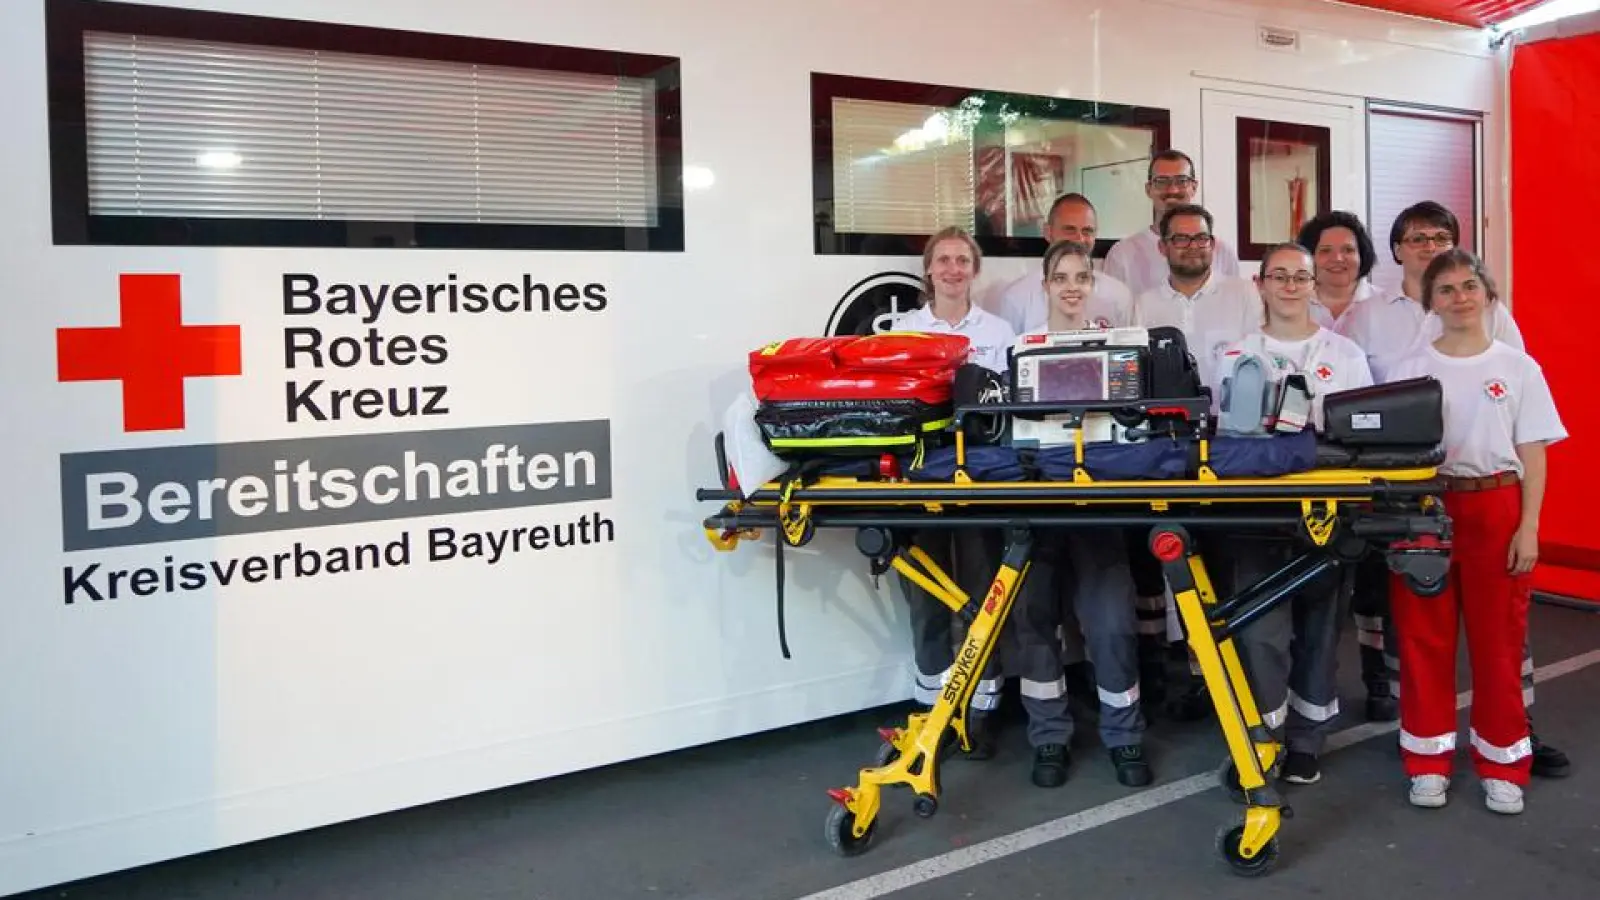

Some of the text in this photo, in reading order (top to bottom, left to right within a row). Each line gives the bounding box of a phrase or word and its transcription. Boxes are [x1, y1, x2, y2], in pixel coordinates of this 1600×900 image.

[282, 273, 607, 323] Bayerisches
[284, 327, 448, 369] Rotes
[286, 379, 449, 423] Kreuz
[86, 444, 596, 530] Bereitschaften
[63, 513, 615, 604] Kreisverband Bayreuth
[943, 638, 979, 704] stryker
